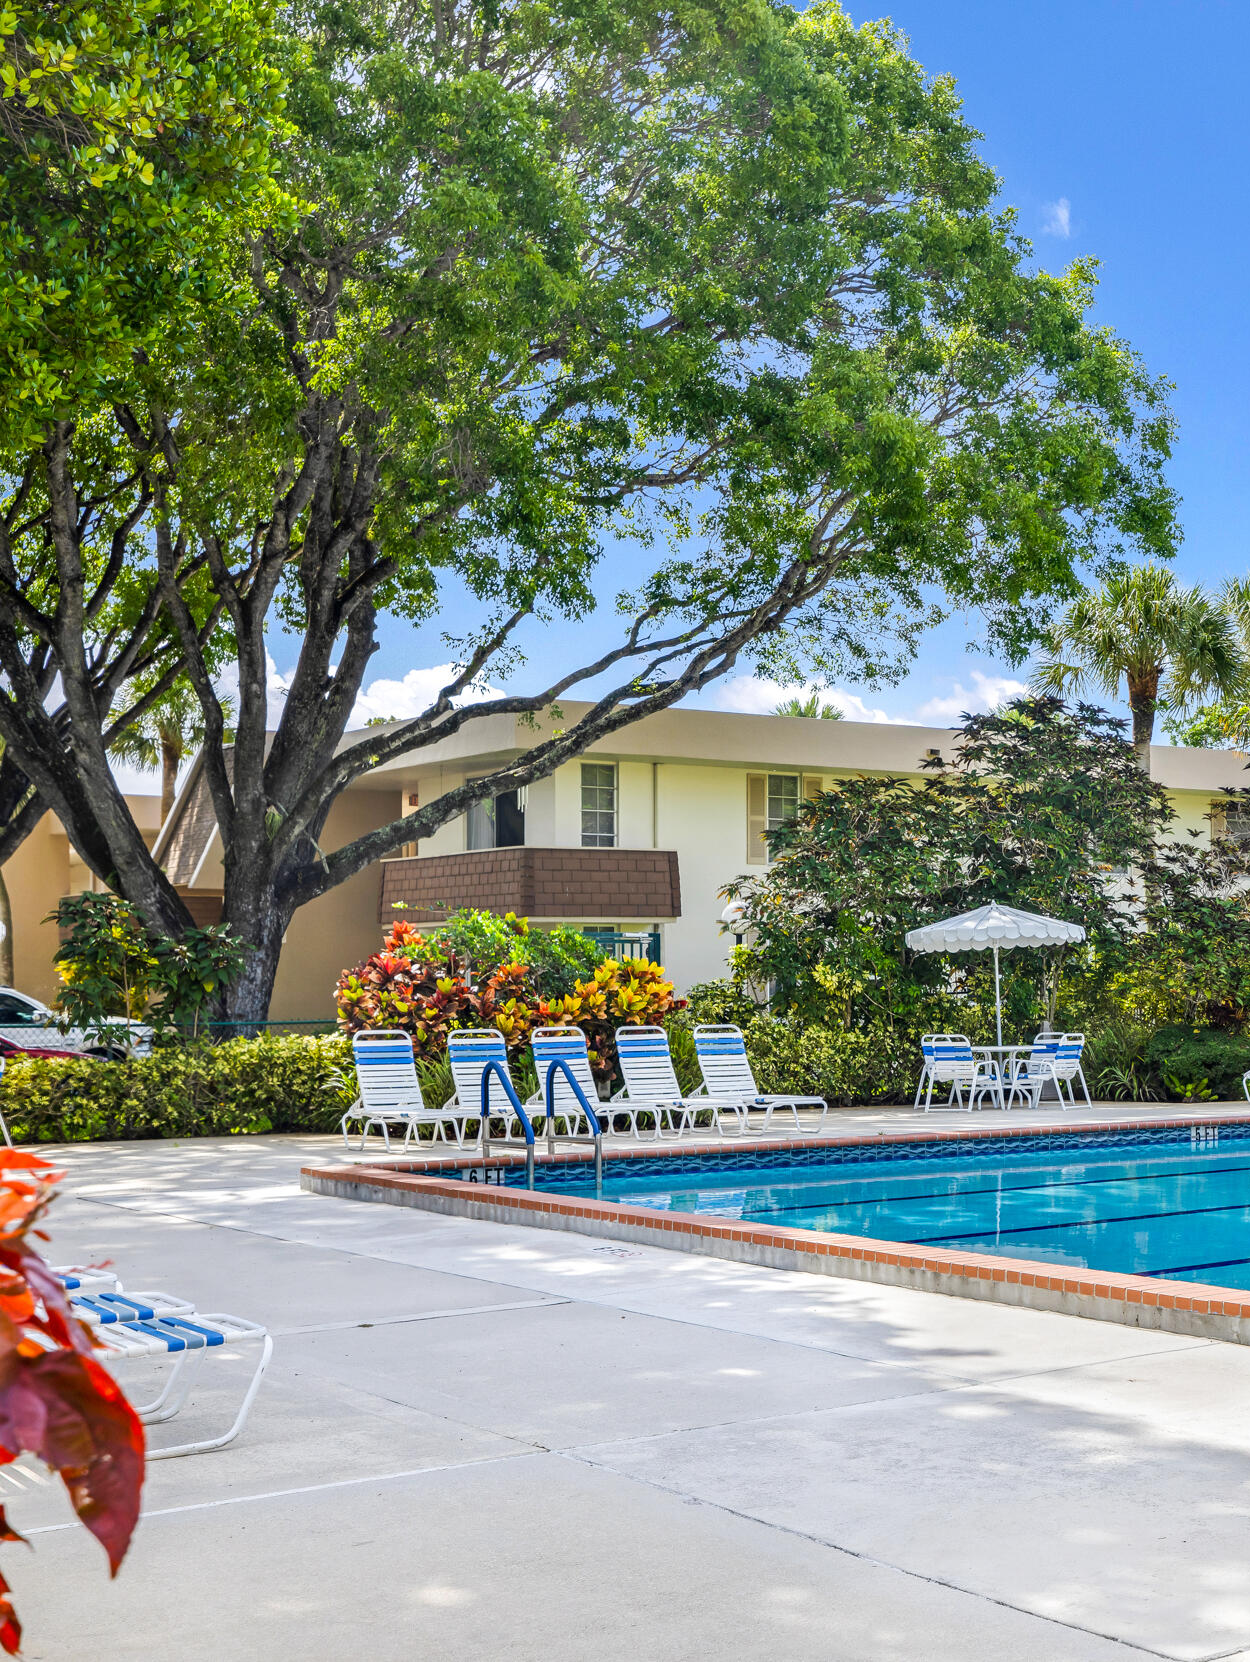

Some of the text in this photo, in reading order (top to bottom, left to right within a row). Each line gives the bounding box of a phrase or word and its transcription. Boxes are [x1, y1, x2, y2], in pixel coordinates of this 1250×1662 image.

[1195, 1126, 1217, 1141] 5 FT
[469, 1167, 504, 1186] 6 FT
